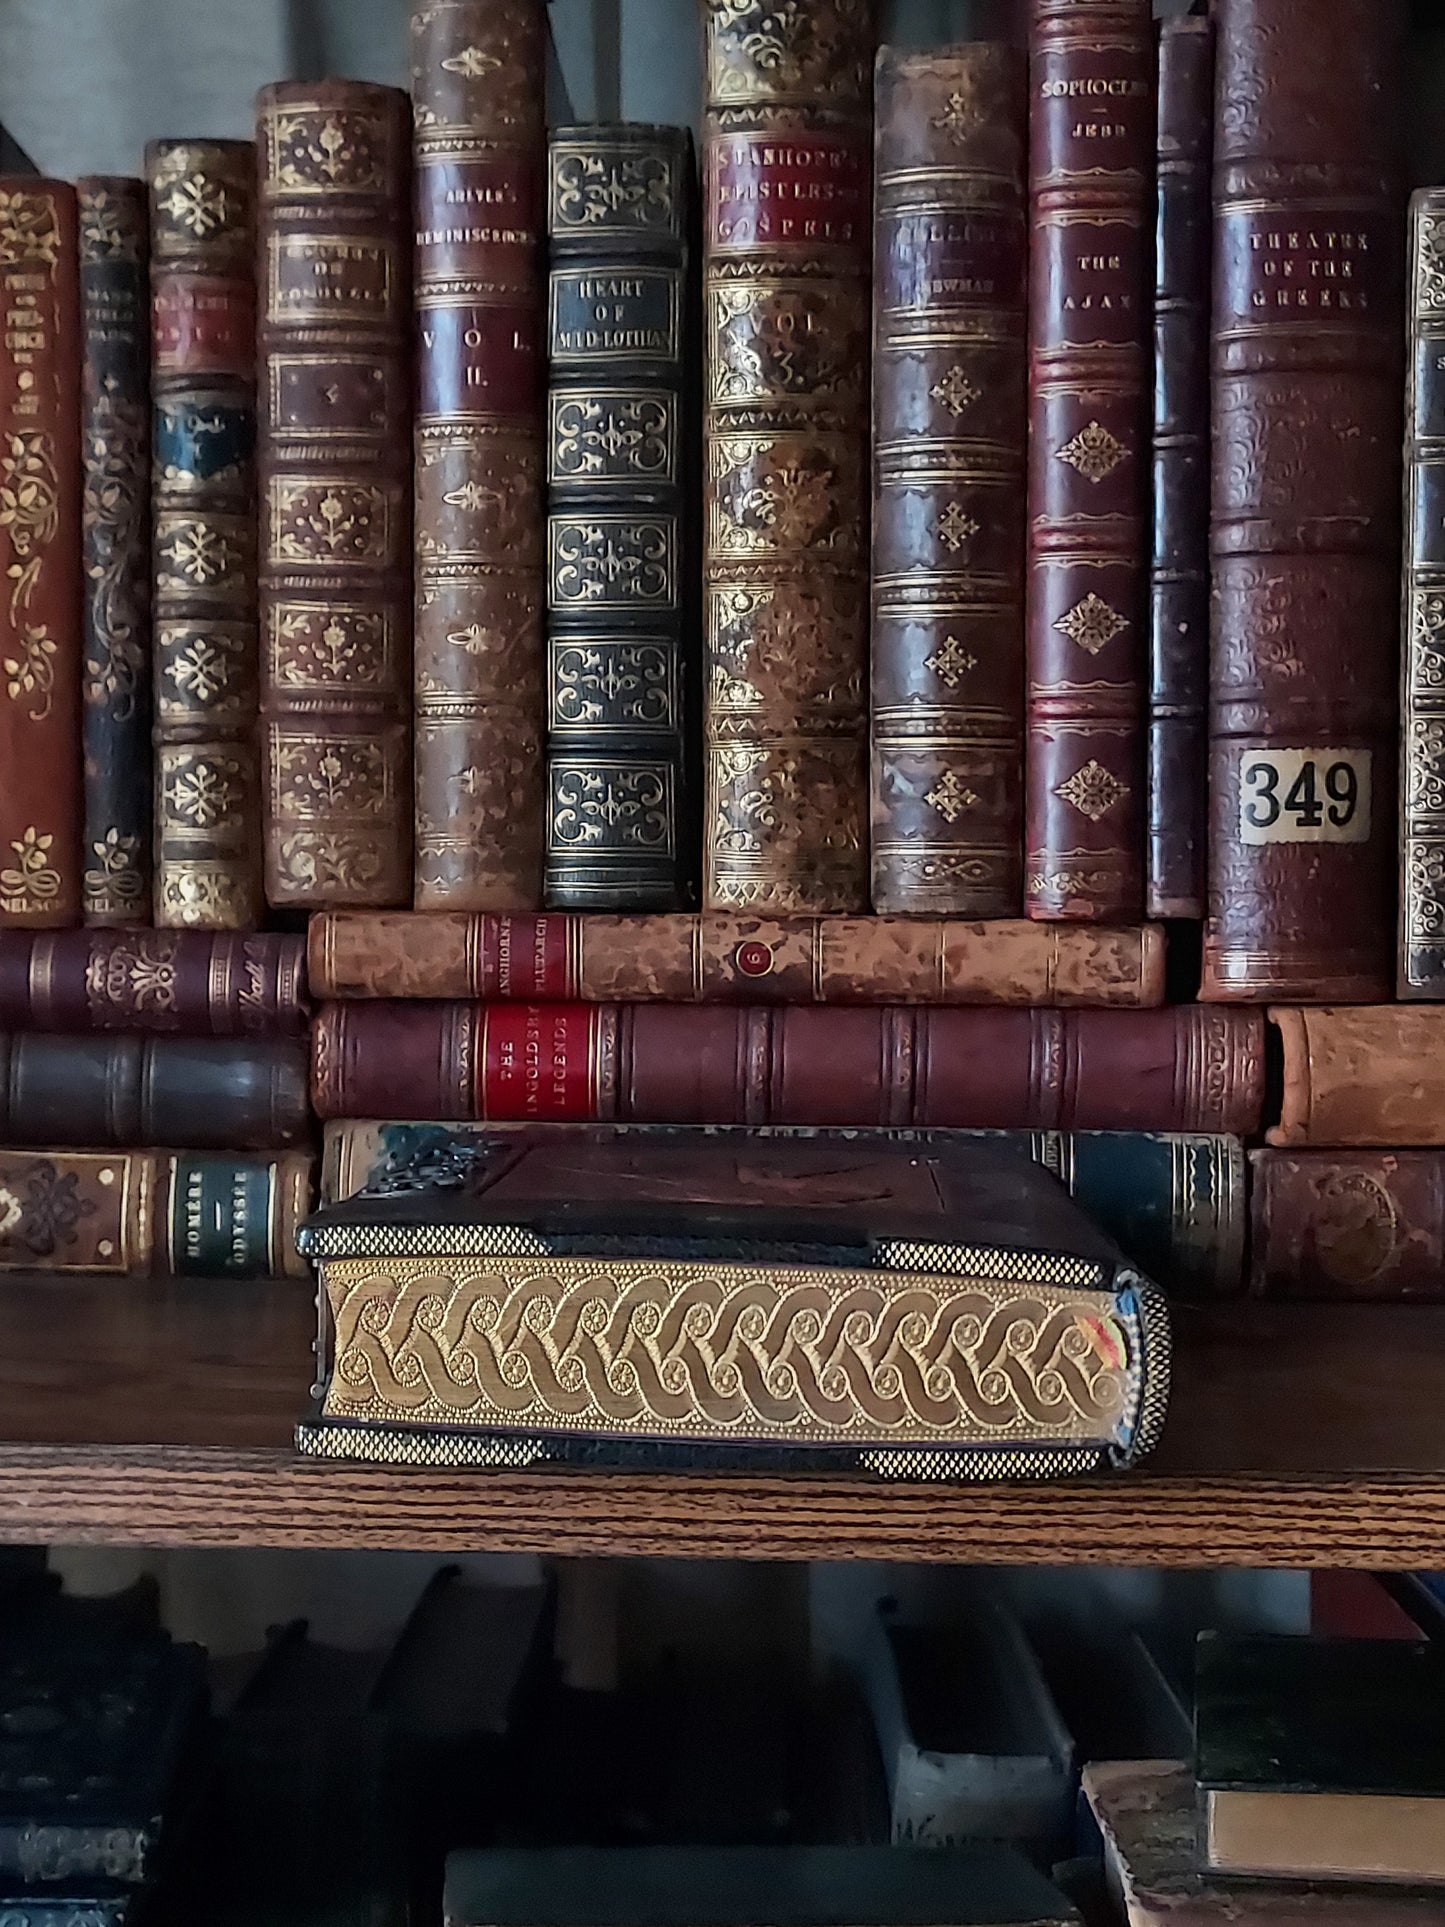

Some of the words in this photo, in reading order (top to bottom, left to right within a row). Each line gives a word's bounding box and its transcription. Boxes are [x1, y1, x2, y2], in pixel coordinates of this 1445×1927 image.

[1041, 79, 1148, 98] SOPHOCL
[1077, 256, 1120, 270] THE
[578, 280, 642, 298] HEART
[1063, 295, 1130, 310] AJAX
[594, 304, 624, 322] OF
[1245, 761, 1358, 829] 349
[500, 1042, 514, 1081] THE
